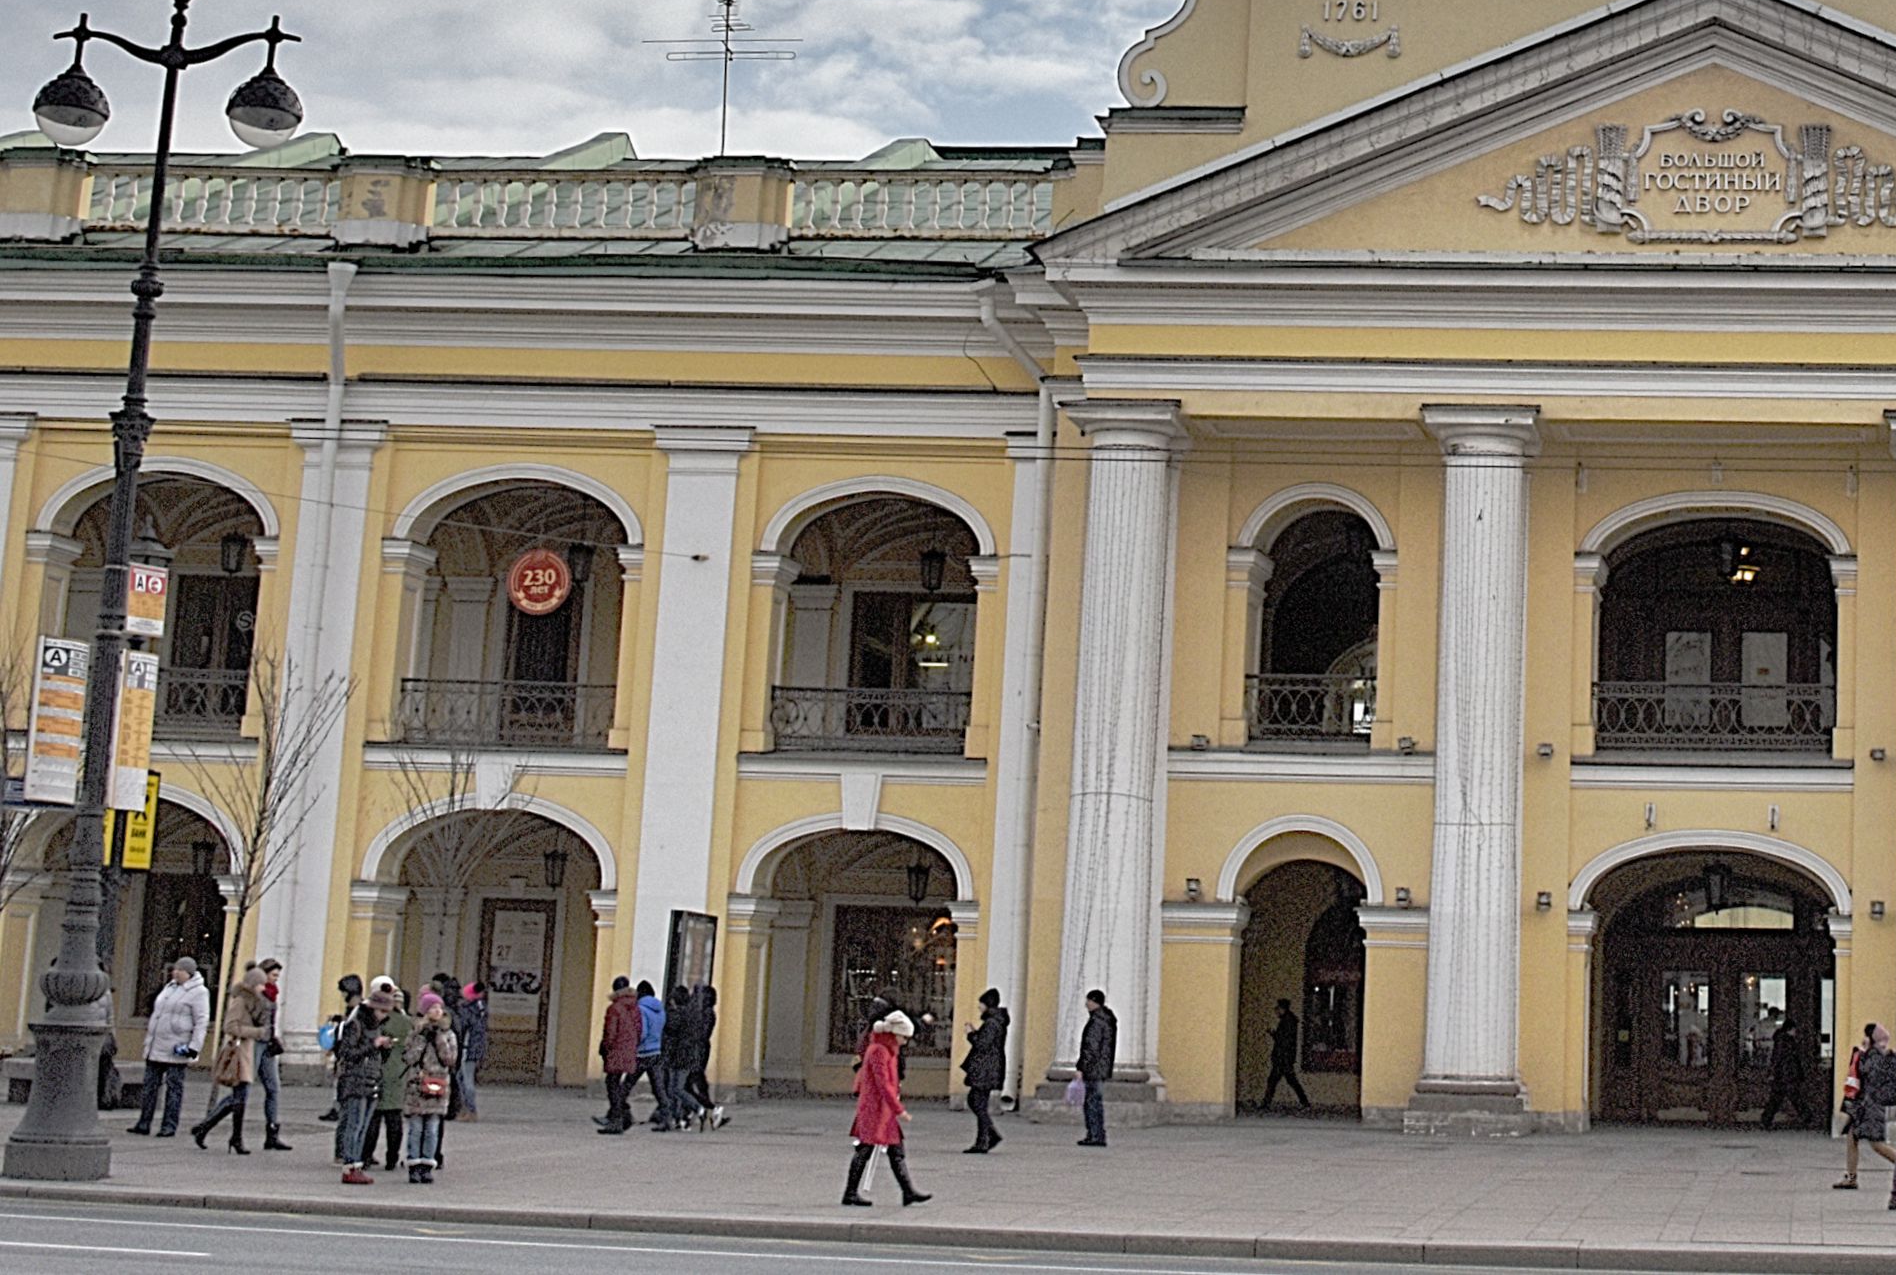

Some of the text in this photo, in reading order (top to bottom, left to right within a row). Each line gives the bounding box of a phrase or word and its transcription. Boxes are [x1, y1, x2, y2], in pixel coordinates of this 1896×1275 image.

[1323, 0, 1379, 22] 1761
[1660, 151, 1765, 168] БОЛЬШОЙ
[1644, 171, 1782, 191] ГОСТИНЫЙ
[1673, 196, 1751, 214] ДВОР
[523, 569, 557, 586] 230
[529, 585, 549, 594] лет
[50, 649, 62, 665] A
